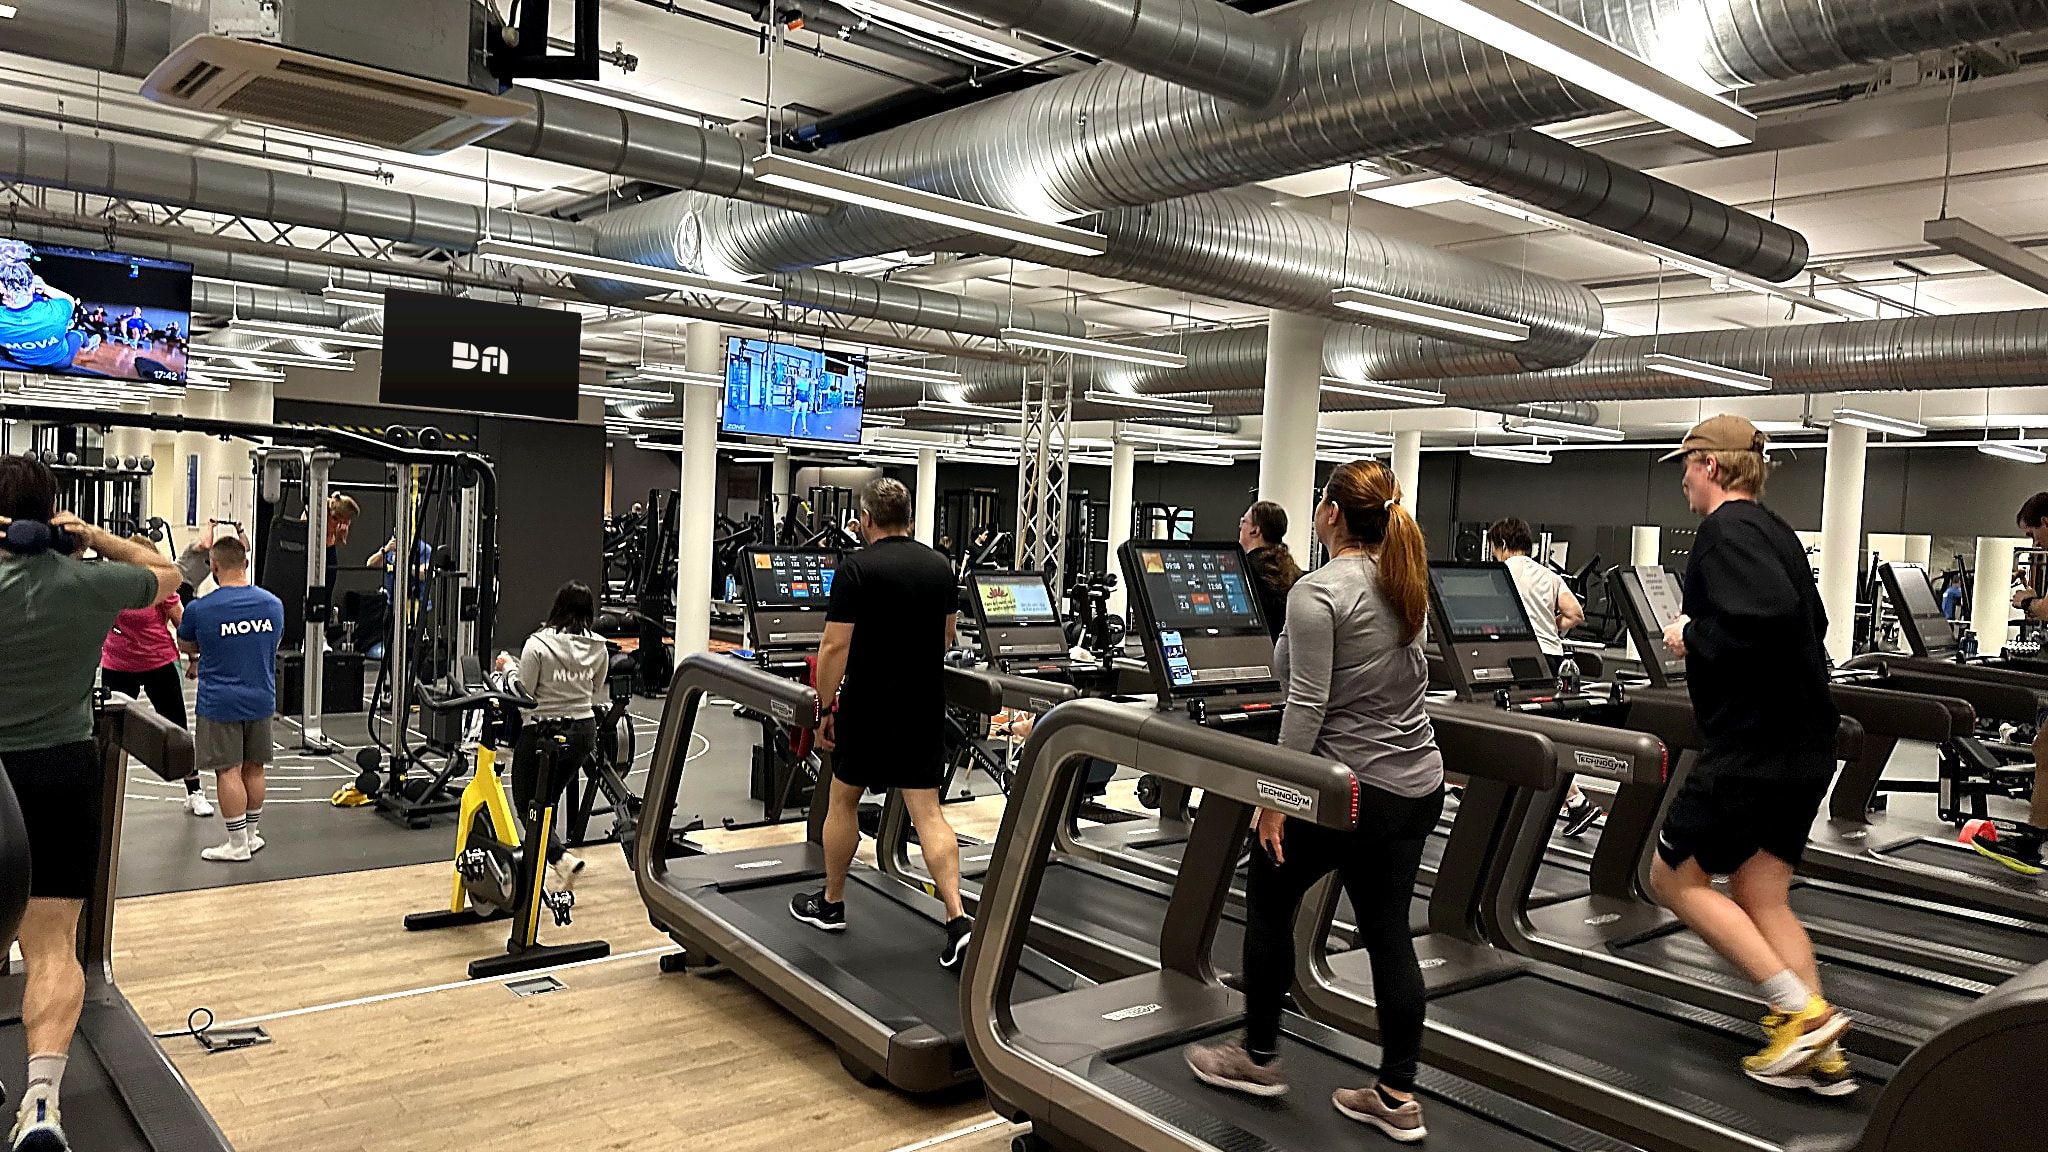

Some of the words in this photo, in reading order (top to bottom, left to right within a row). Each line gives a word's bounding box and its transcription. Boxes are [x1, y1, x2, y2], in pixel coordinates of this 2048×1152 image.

[6, 336, 60, 350] MOVA
[153, 370, 178, 381] 17:42
[221, 619, 273, 637] MOVA
[1258, 781, 1311, 807] TECHNOGYM
[529, 808, 537, 822] 01
